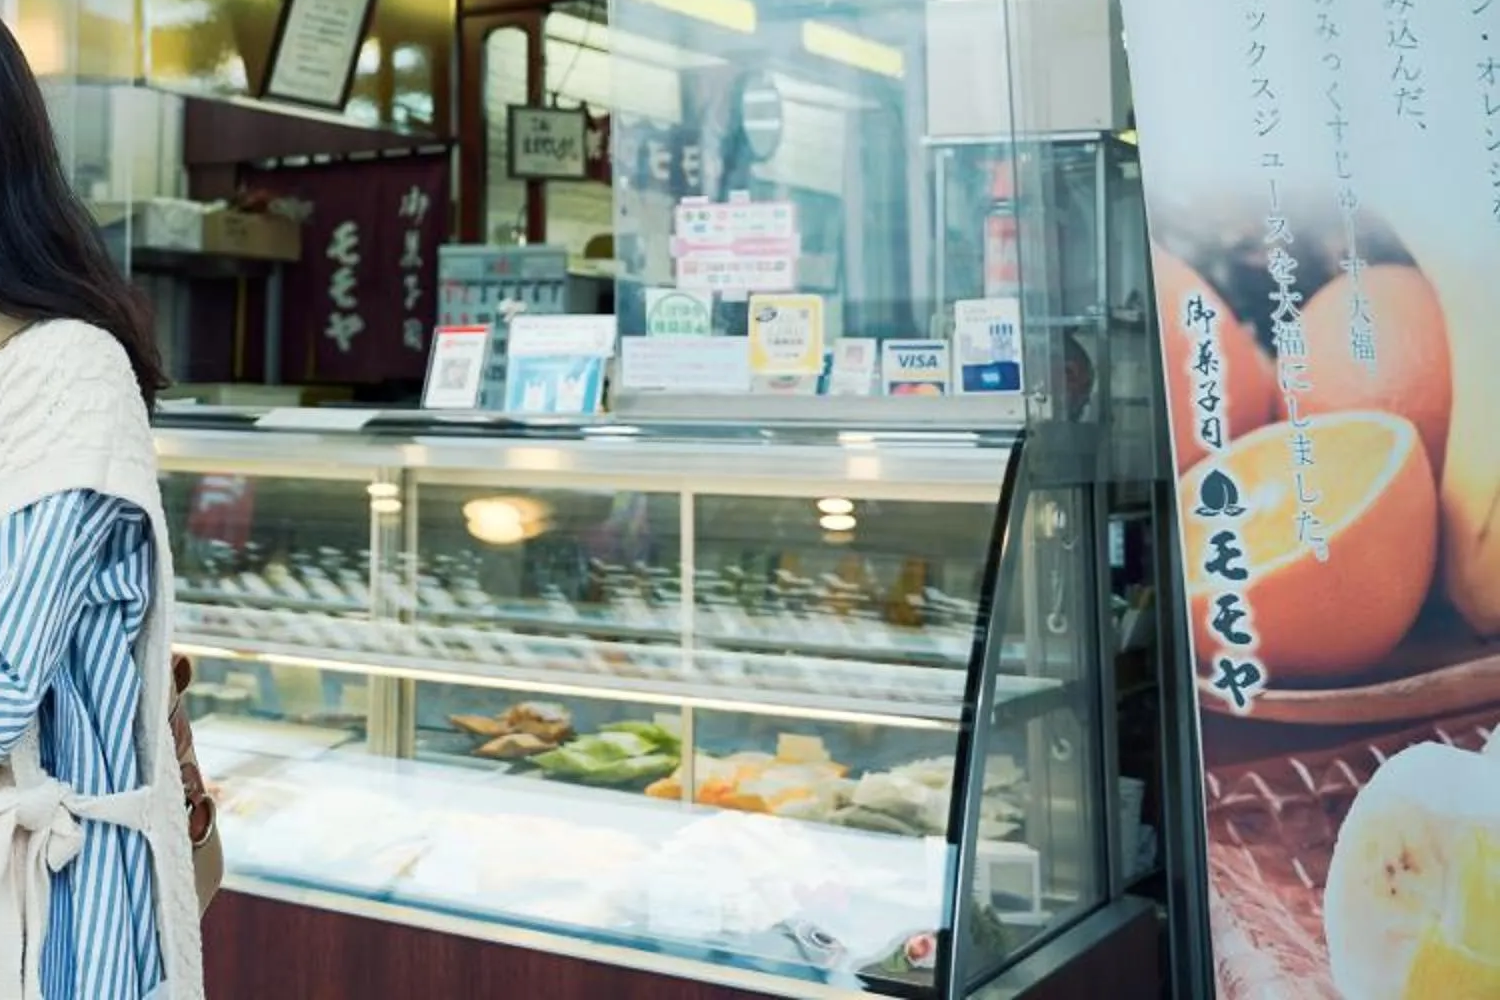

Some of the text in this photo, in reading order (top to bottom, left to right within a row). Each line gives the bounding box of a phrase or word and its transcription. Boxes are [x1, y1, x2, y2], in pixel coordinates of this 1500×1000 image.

[324, 220, 366, 354] モモヤ
[898, 353, 939, 369] VISA
[1204, 531, 1262, 708] モモヤ
